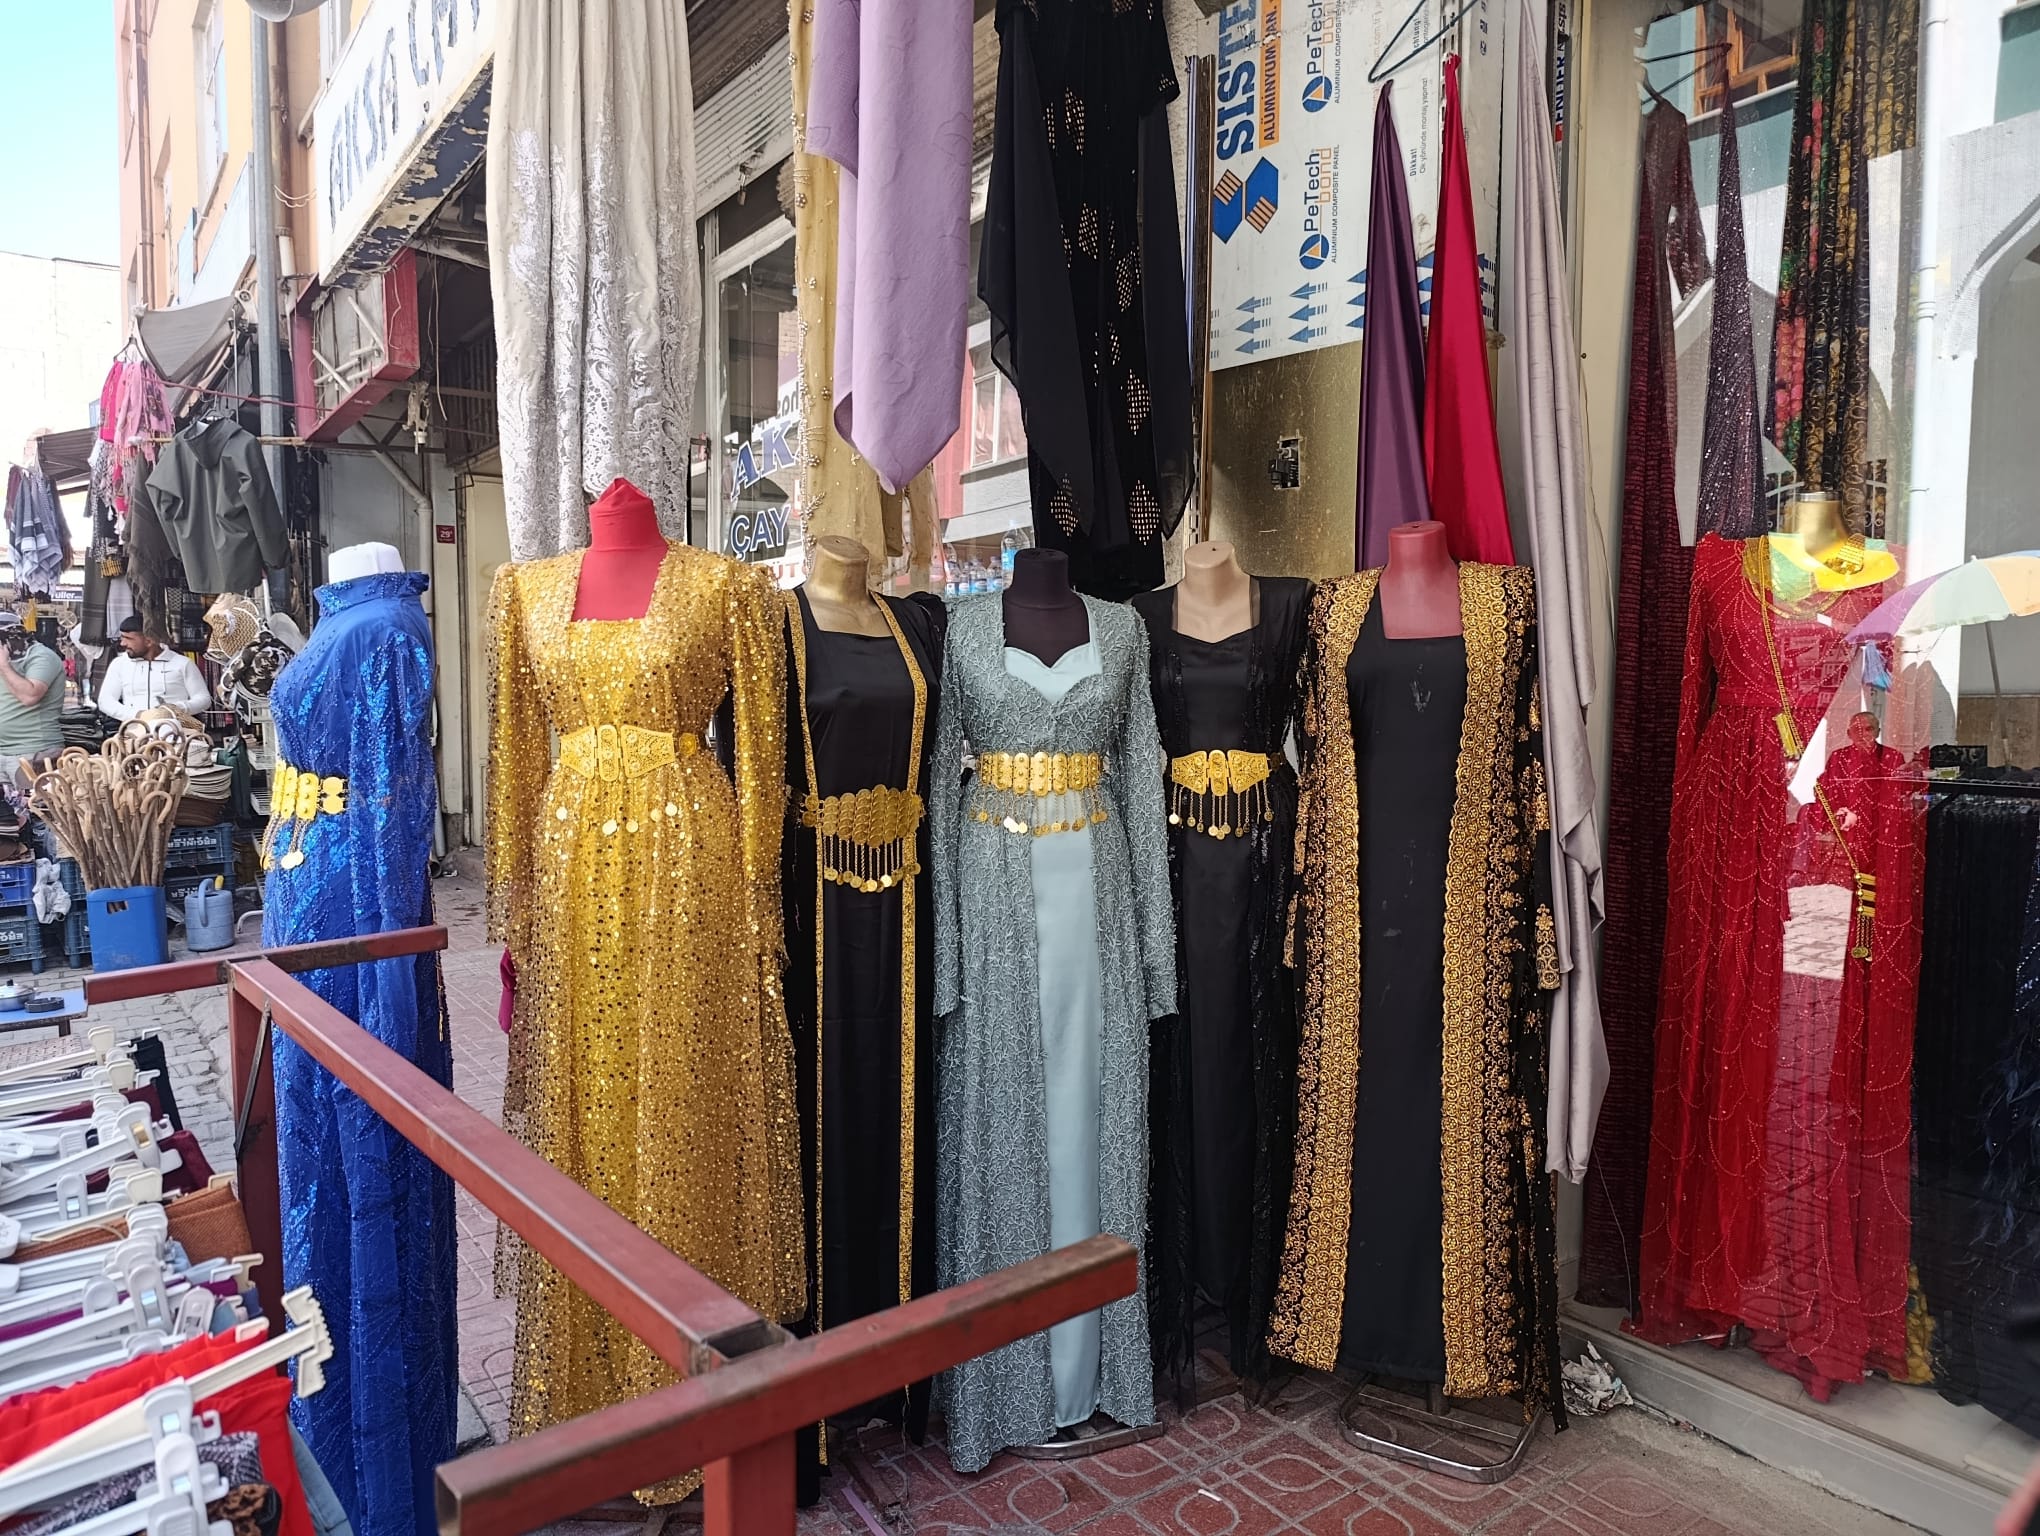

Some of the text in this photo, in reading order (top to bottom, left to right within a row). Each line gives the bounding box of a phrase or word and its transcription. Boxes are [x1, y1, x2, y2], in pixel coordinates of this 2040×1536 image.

[1303, 151, 1318, 232] PeTech
[1315, 147, 1332, 205] bond
[731, 418, 803, 499] AK
[730, 503, 791, 562] ÇAY
